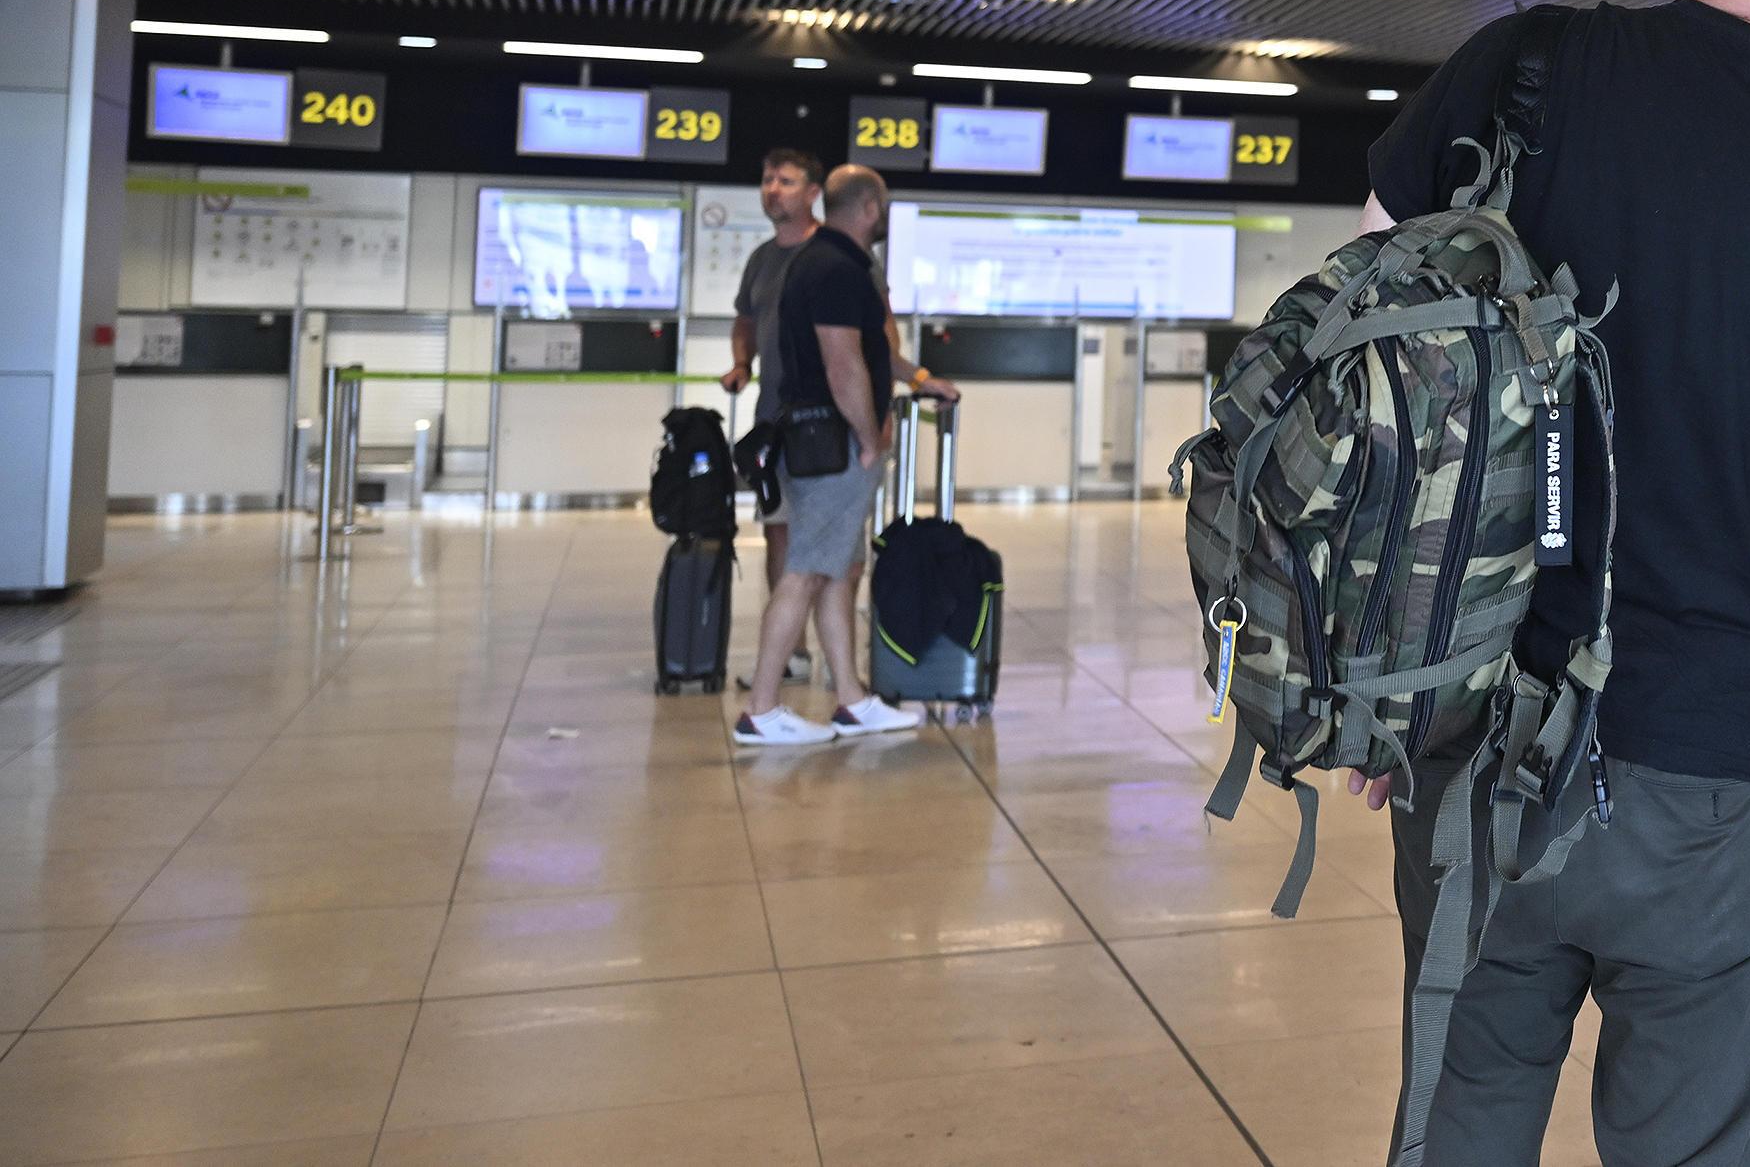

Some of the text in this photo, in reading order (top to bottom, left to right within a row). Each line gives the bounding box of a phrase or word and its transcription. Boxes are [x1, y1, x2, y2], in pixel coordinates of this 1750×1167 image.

[302, 92, 375, 126] 240
[656, 109, 721, 141] 239
[856, 118, 918, 148] 238
[1237, 135, 1292, 164] 237
[1547, 432, 1561, 531] PARA SERVIR
